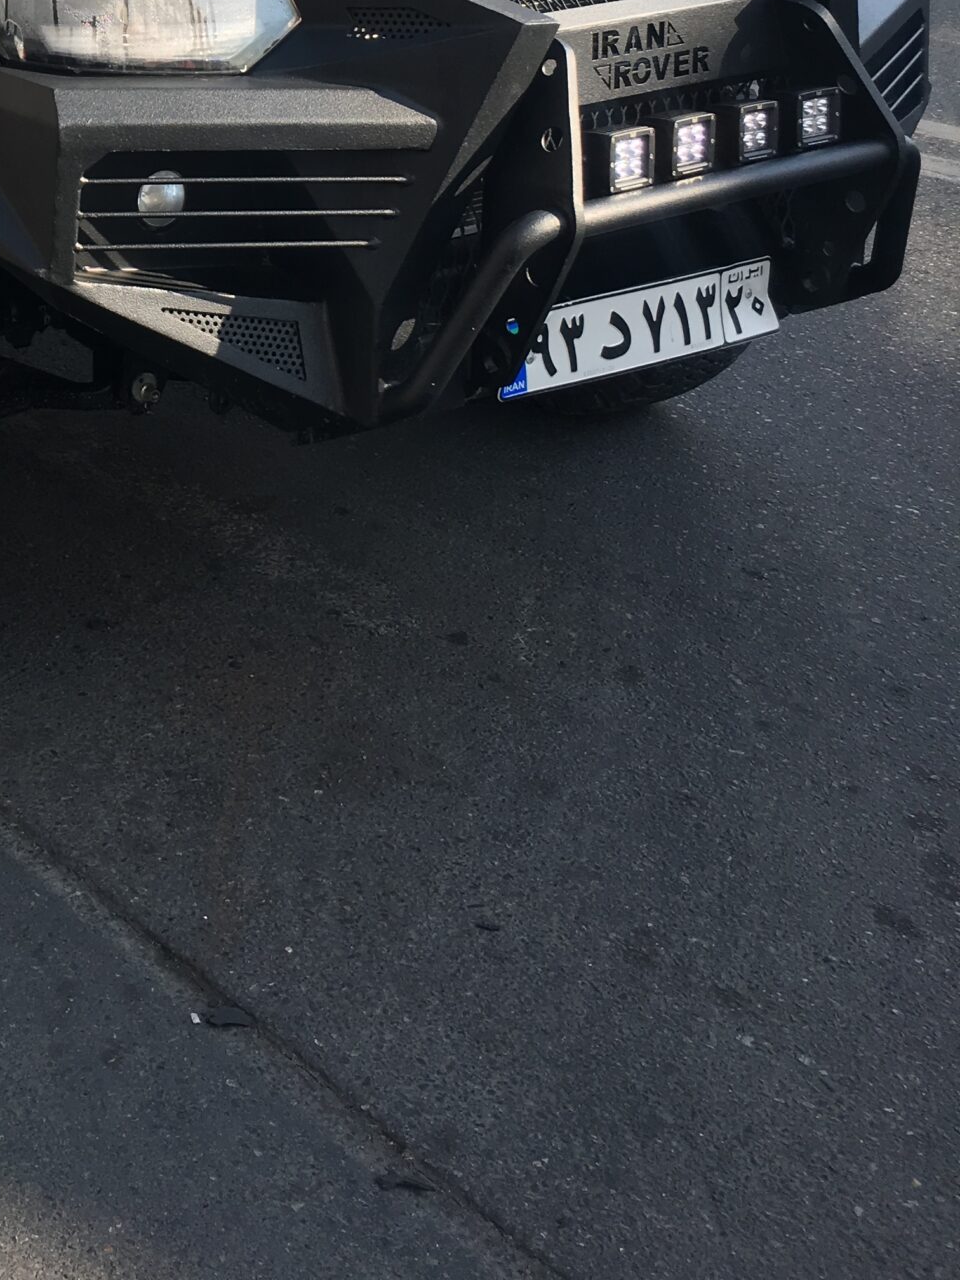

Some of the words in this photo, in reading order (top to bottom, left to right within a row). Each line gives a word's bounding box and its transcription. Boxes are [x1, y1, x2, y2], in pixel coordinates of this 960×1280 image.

[592, 21, 665, 61] IRAN
[614, 46, 710, 89] ROVER
[728, 265, 763, 284] ایران
